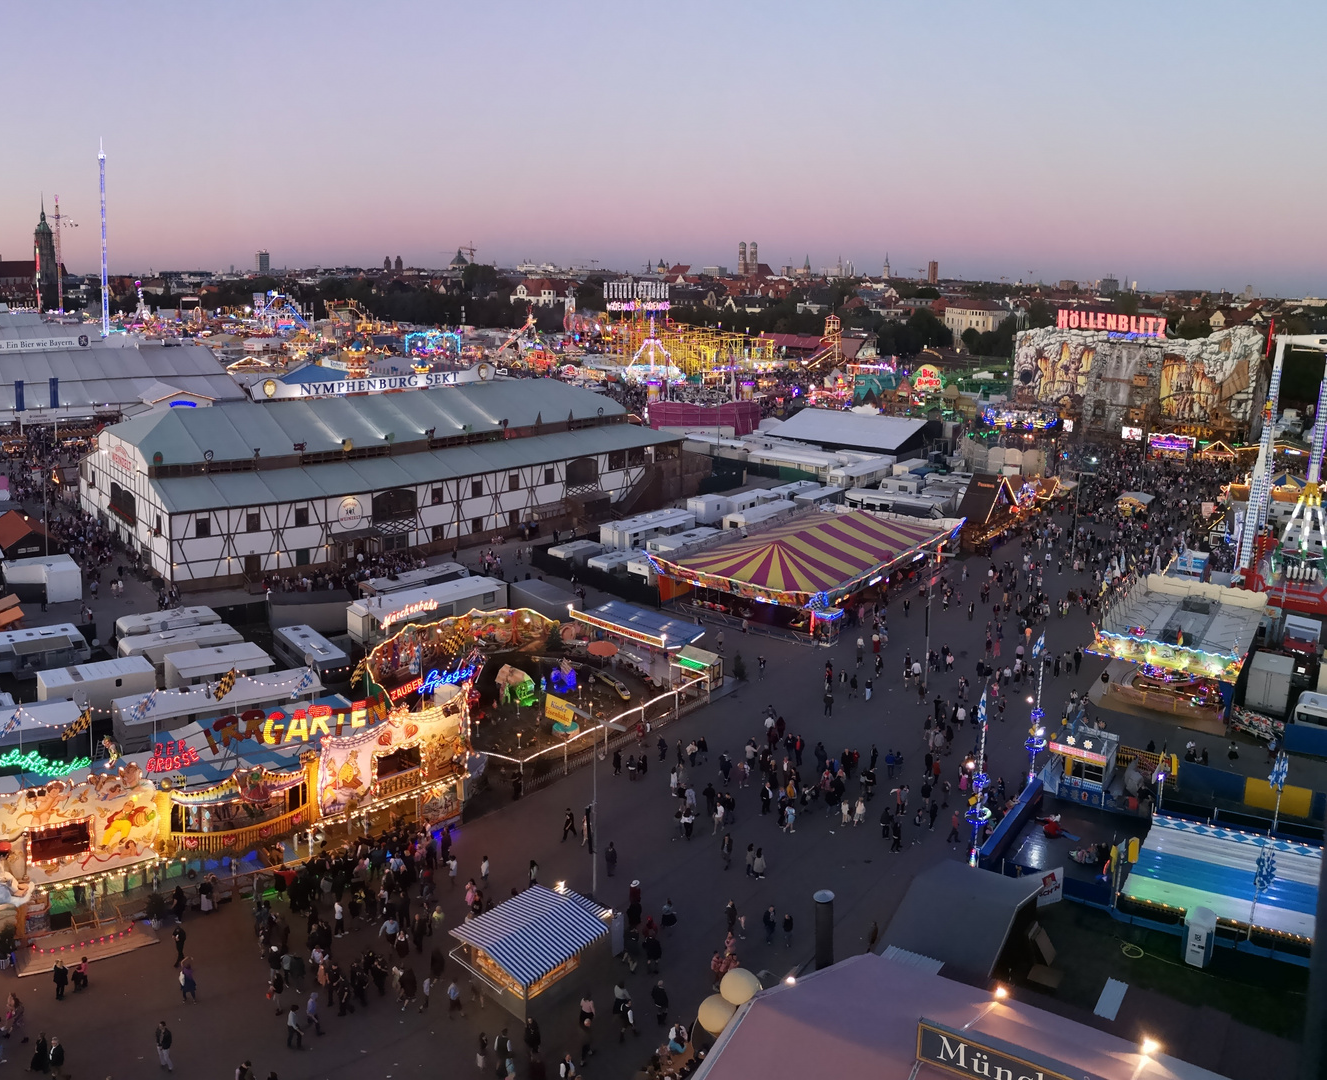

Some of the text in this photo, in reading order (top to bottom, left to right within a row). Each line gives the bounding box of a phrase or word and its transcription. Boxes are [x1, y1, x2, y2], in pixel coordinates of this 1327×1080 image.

[1058, 309, 1167, 339] HÖLLENBLITZ
[6, 341, 19, 349] Ein
[20, 339, 35, 348] Bier
[36, 339, 48, 347] wie
[49, 337, 75, 349] Bayern.
[300, 371, 460, 396] NYMPHENBURG SEKT
[922, 368, 934, 378] BIG
[380, 598, 439, 630] Märchenbahn
[390, 678, 424, 700] ZAUBER
[203, 693, 389, 756] IRRGARTEN
[146, 747, 200, 772] GROSSE
[154, 738, 186, 757] DER
